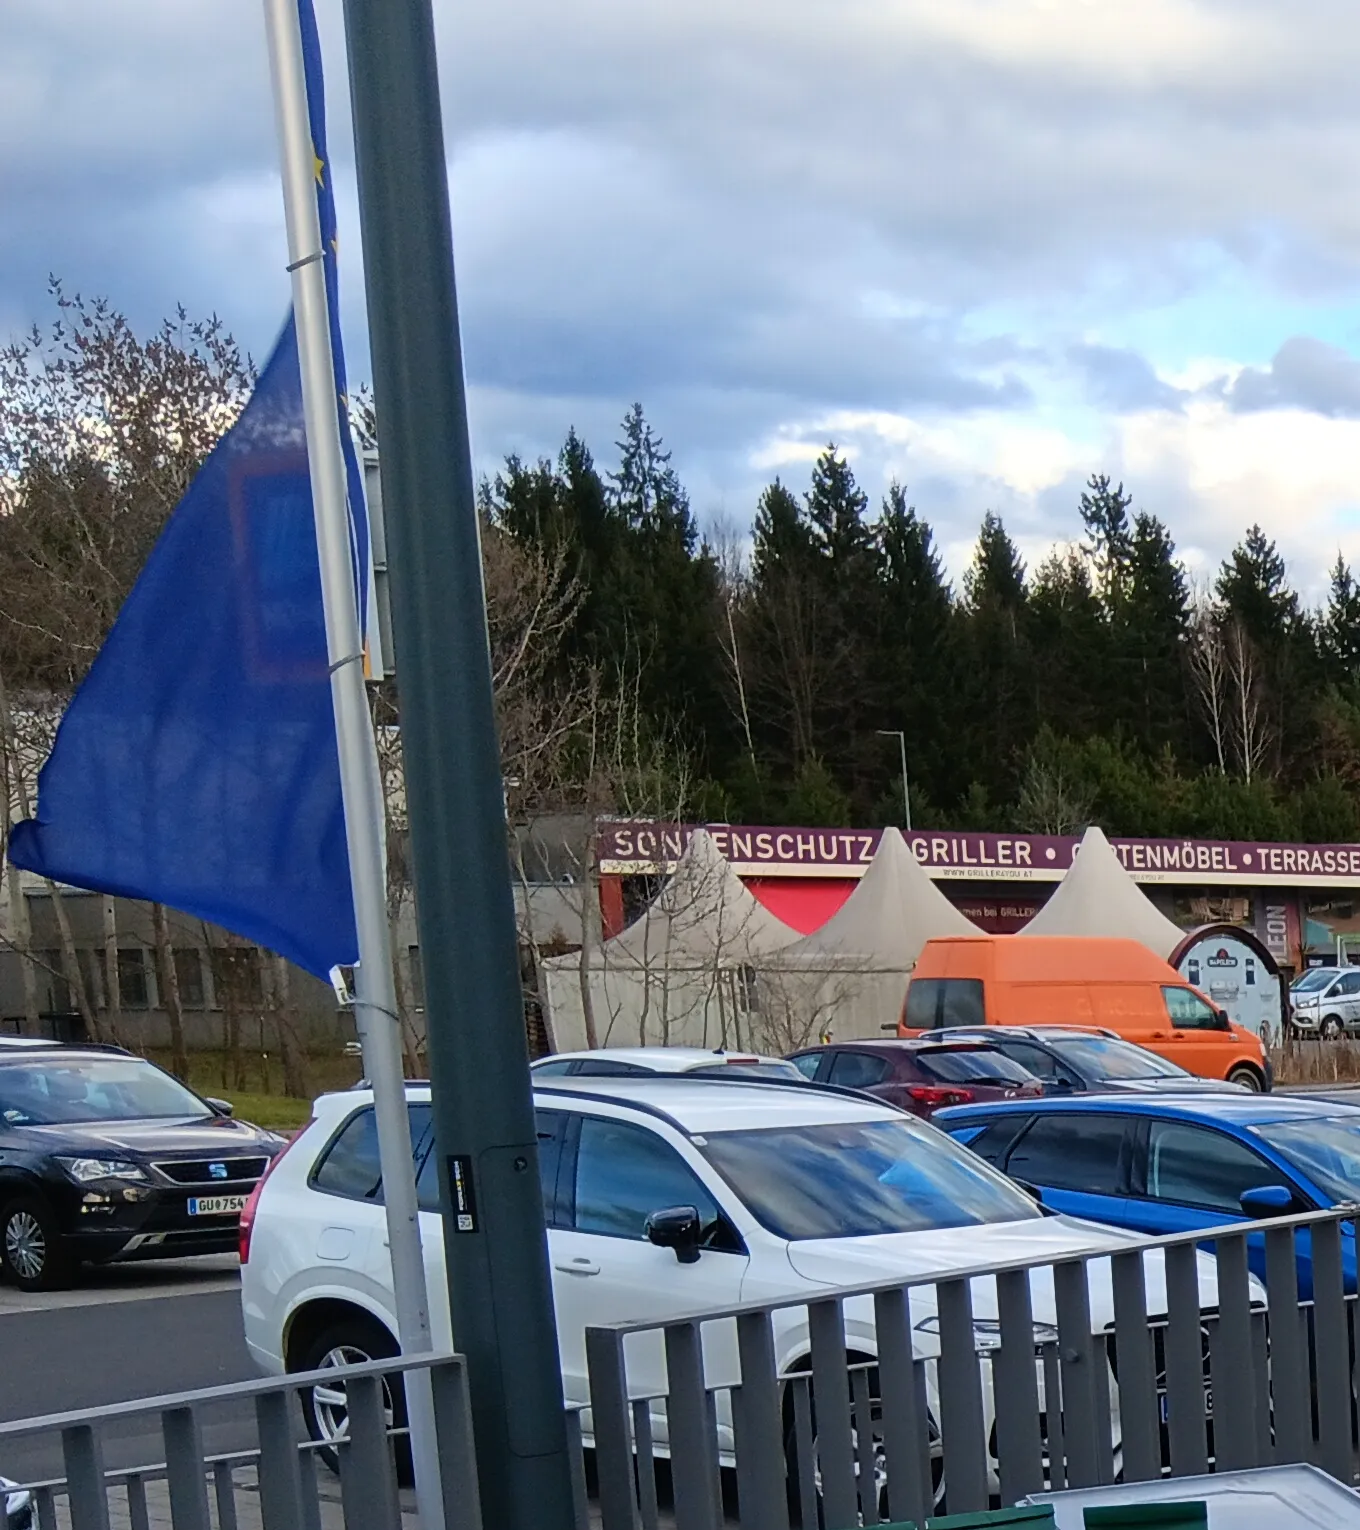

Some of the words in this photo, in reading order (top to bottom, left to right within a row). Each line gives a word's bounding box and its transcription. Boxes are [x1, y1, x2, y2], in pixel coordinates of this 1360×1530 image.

[614, 829, 876, 862] SONENSCHUTZ
[911, 837, 1033, 866] GRILLER
[199, 1200, 214, 1211] GU
[222, 1197, 248, 1210] 754
